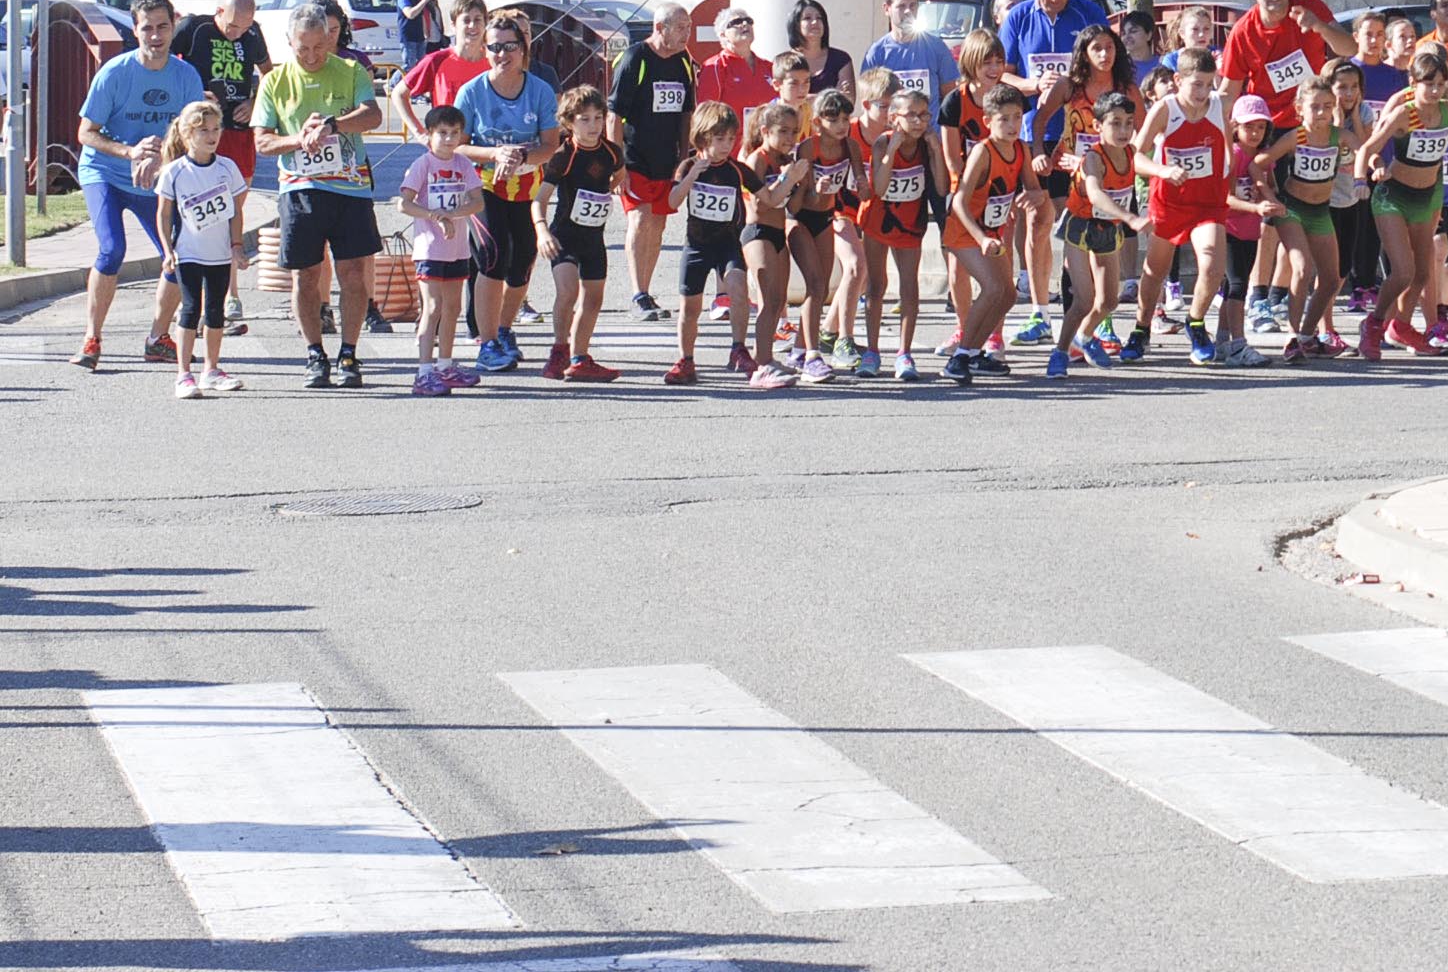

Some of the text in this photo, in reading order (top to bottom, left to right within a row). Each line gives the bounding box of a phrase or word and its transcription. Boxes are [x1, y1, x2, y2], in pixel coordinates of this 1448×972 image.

[212, 48, 236, 62] SIS
[211, 62, 245, 80] CAR
[1275, 61, 1303, 83] 345
[659, 90, 683, 104] 398
[1416, 139, 1446, 153] 339
[302, 146, 335, 166] 386
[1300, 156, 1331, 172] 308
[889, 176, 919, 193] 375
[193, 196, 228, 221] 343
[580, 202, 609, 218] 325
[695, 193, 729, 211] 326
